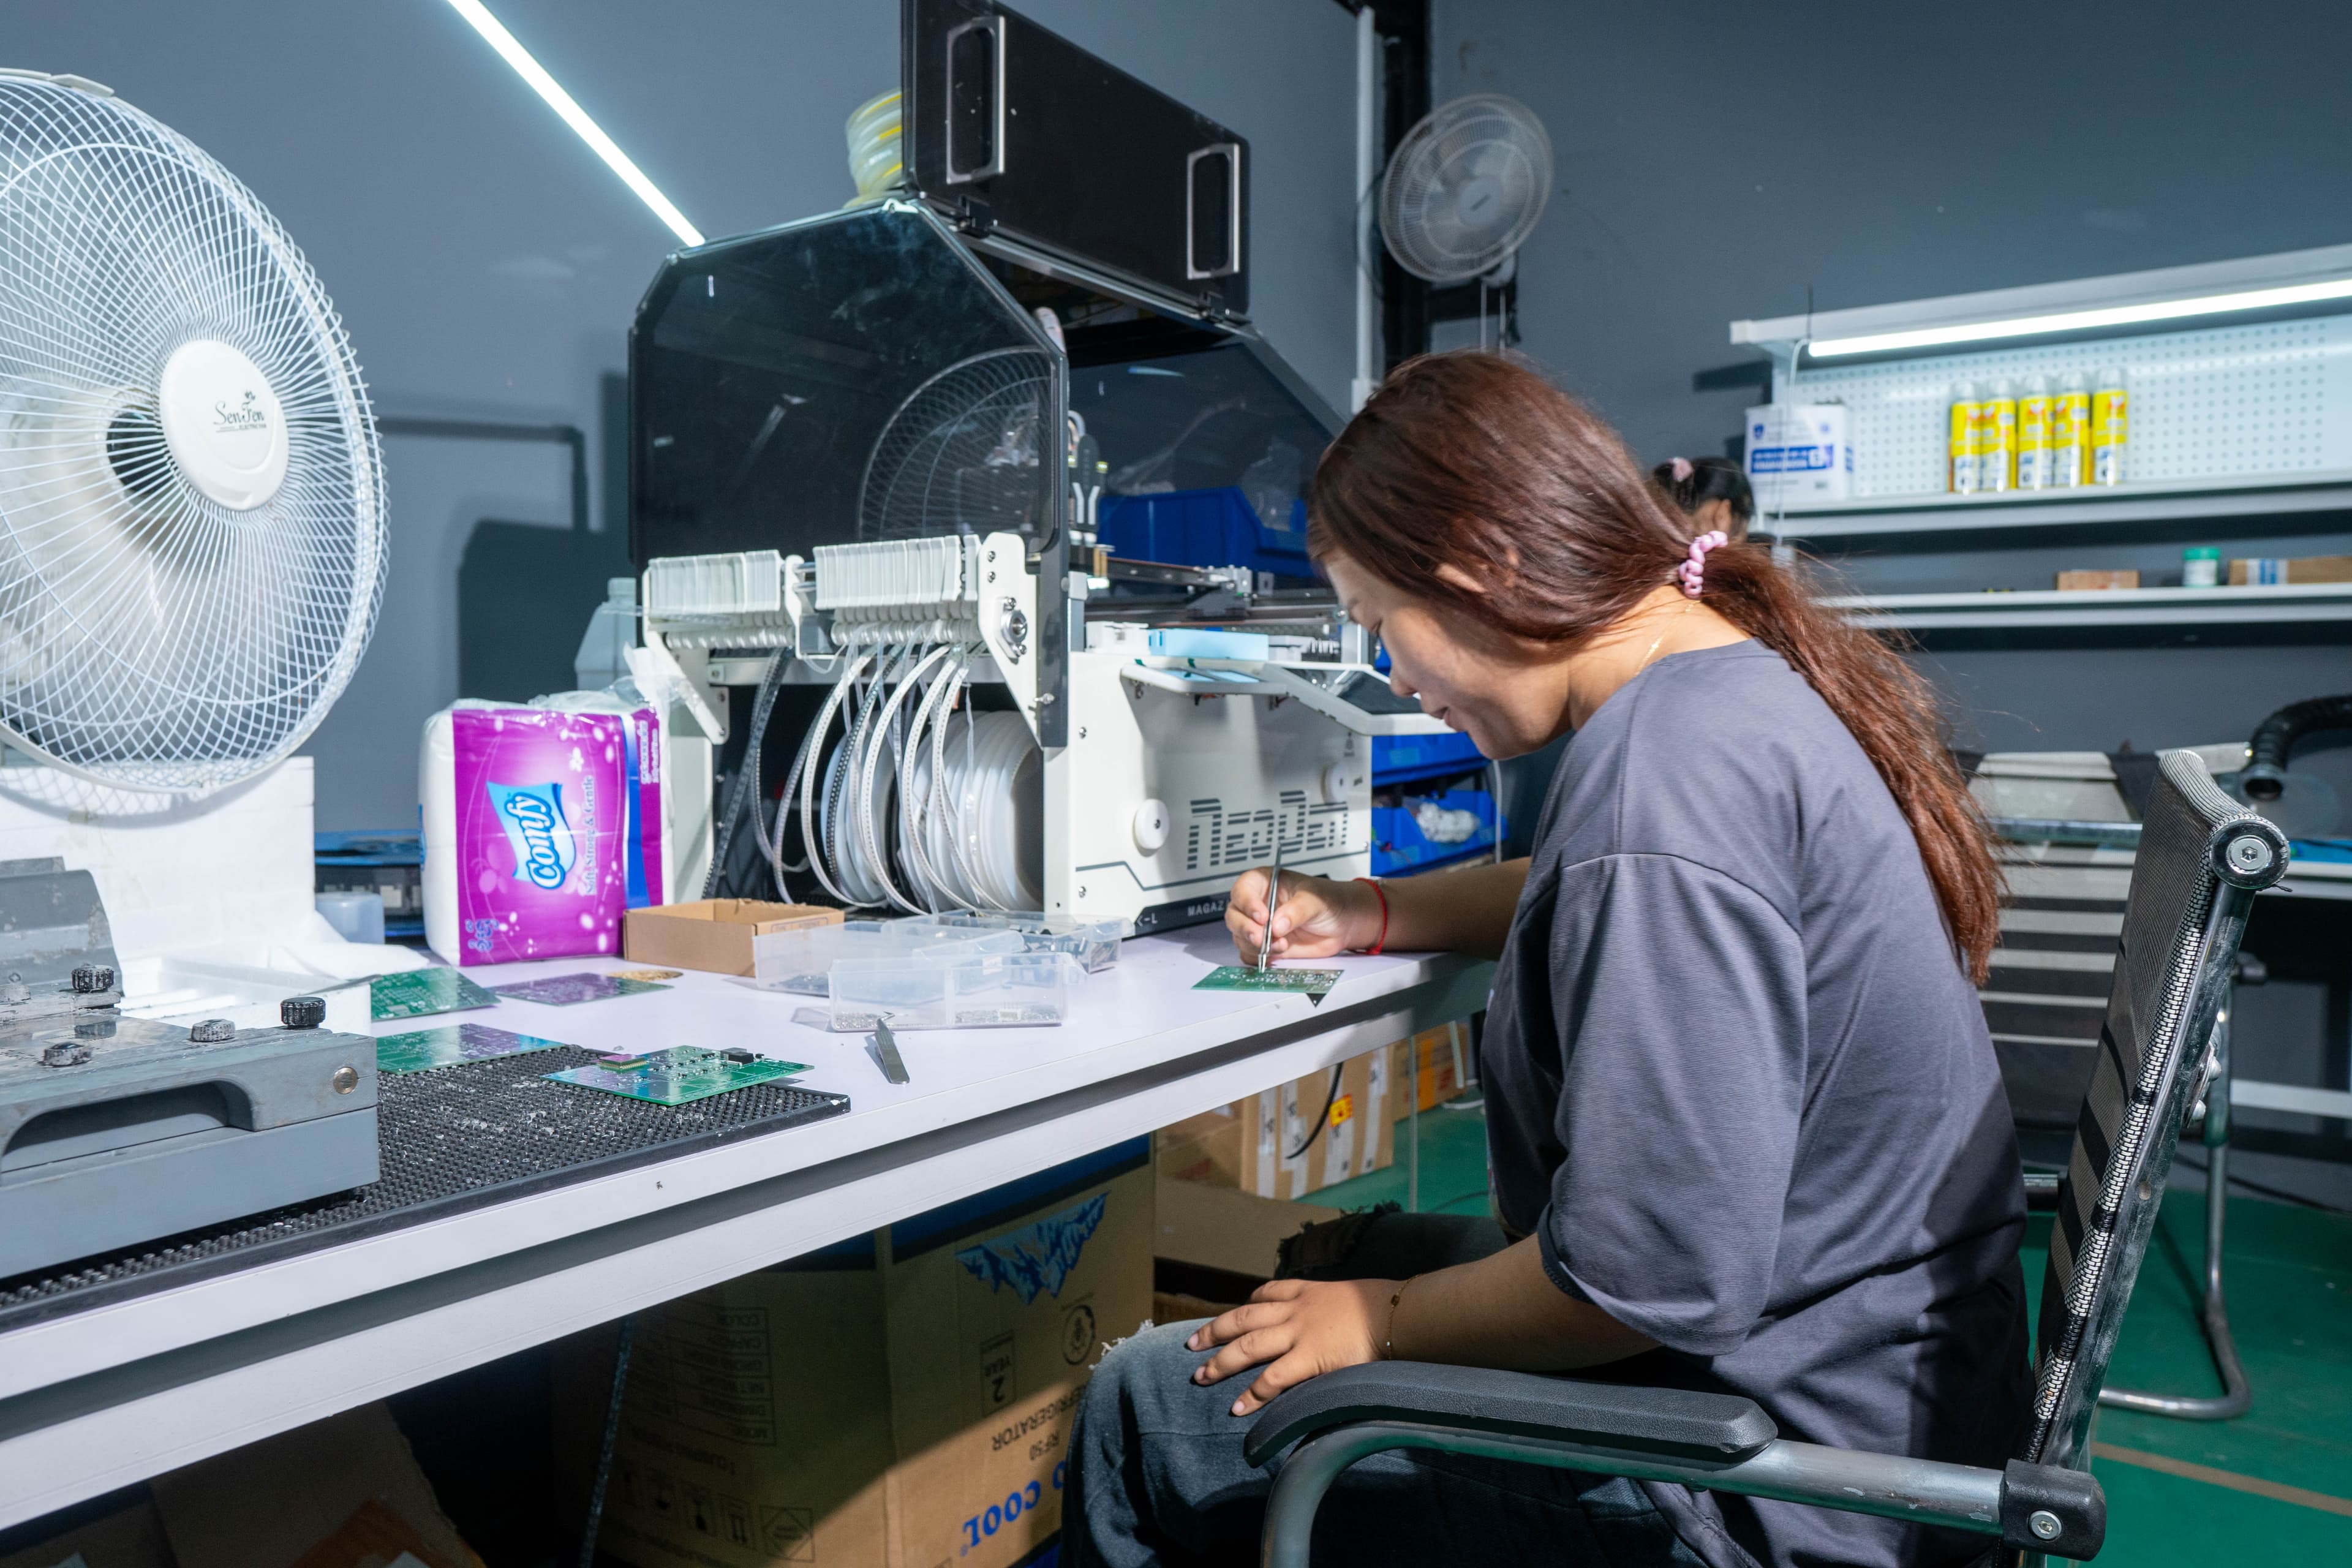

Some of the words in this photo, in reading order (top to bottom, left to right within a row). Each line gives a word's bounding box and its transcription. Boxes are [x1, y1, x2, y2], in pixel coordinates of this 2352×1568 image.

[582, 775, 595, 813] Gentle
[584, 817, 595, 827] &
[506, 794, 564, 888] Comfy
[584, 829, 598, 866] Strong
[1187, 899, 1229, 917] MAGAZ
[992, 1377, 1006, 1404] 2
[992, 1384, 1087, 1451] EFRIGERATOR
[962, 1479, 1042, 1548] COOL
